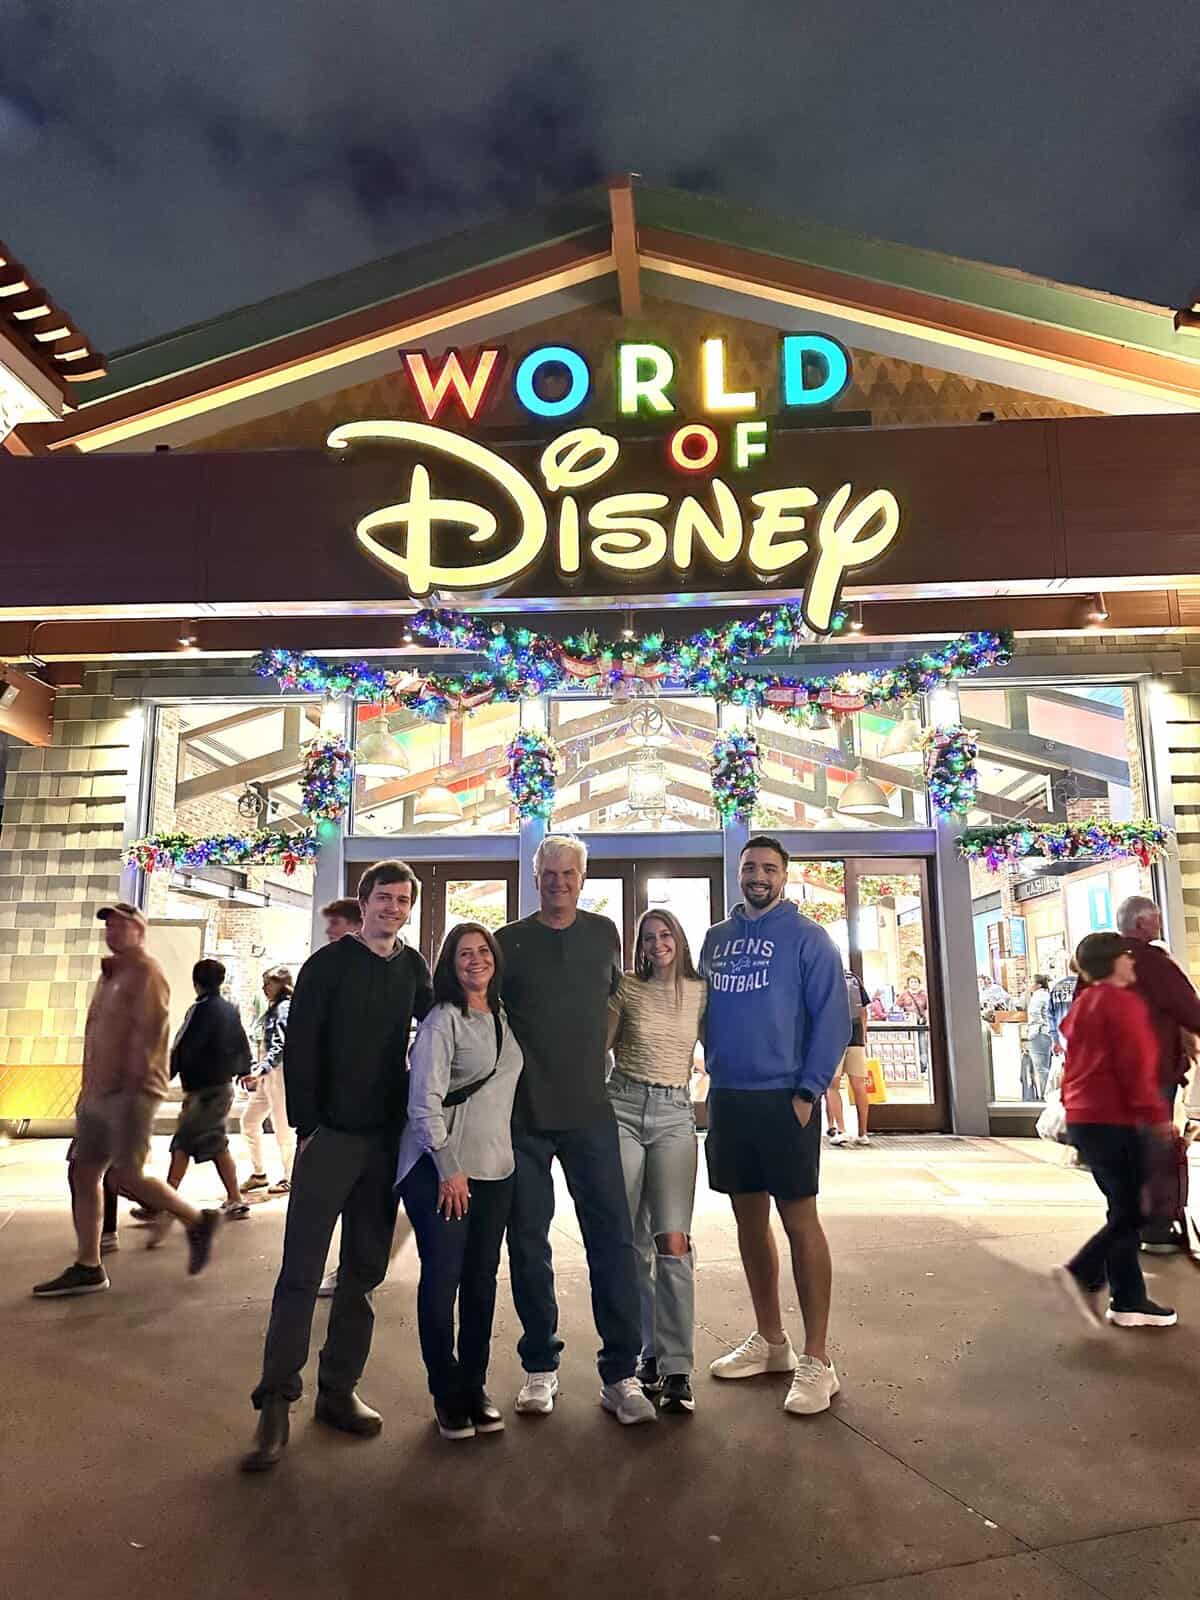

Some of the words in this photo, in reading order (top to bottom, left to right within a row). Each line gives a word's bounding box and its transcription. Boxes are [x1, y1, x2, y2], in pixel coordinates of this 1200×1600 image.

[402, 333, 850, 421] WORLD
[670, 421, 768, 471] OF
[712, 937, 775, 960] LIONS
